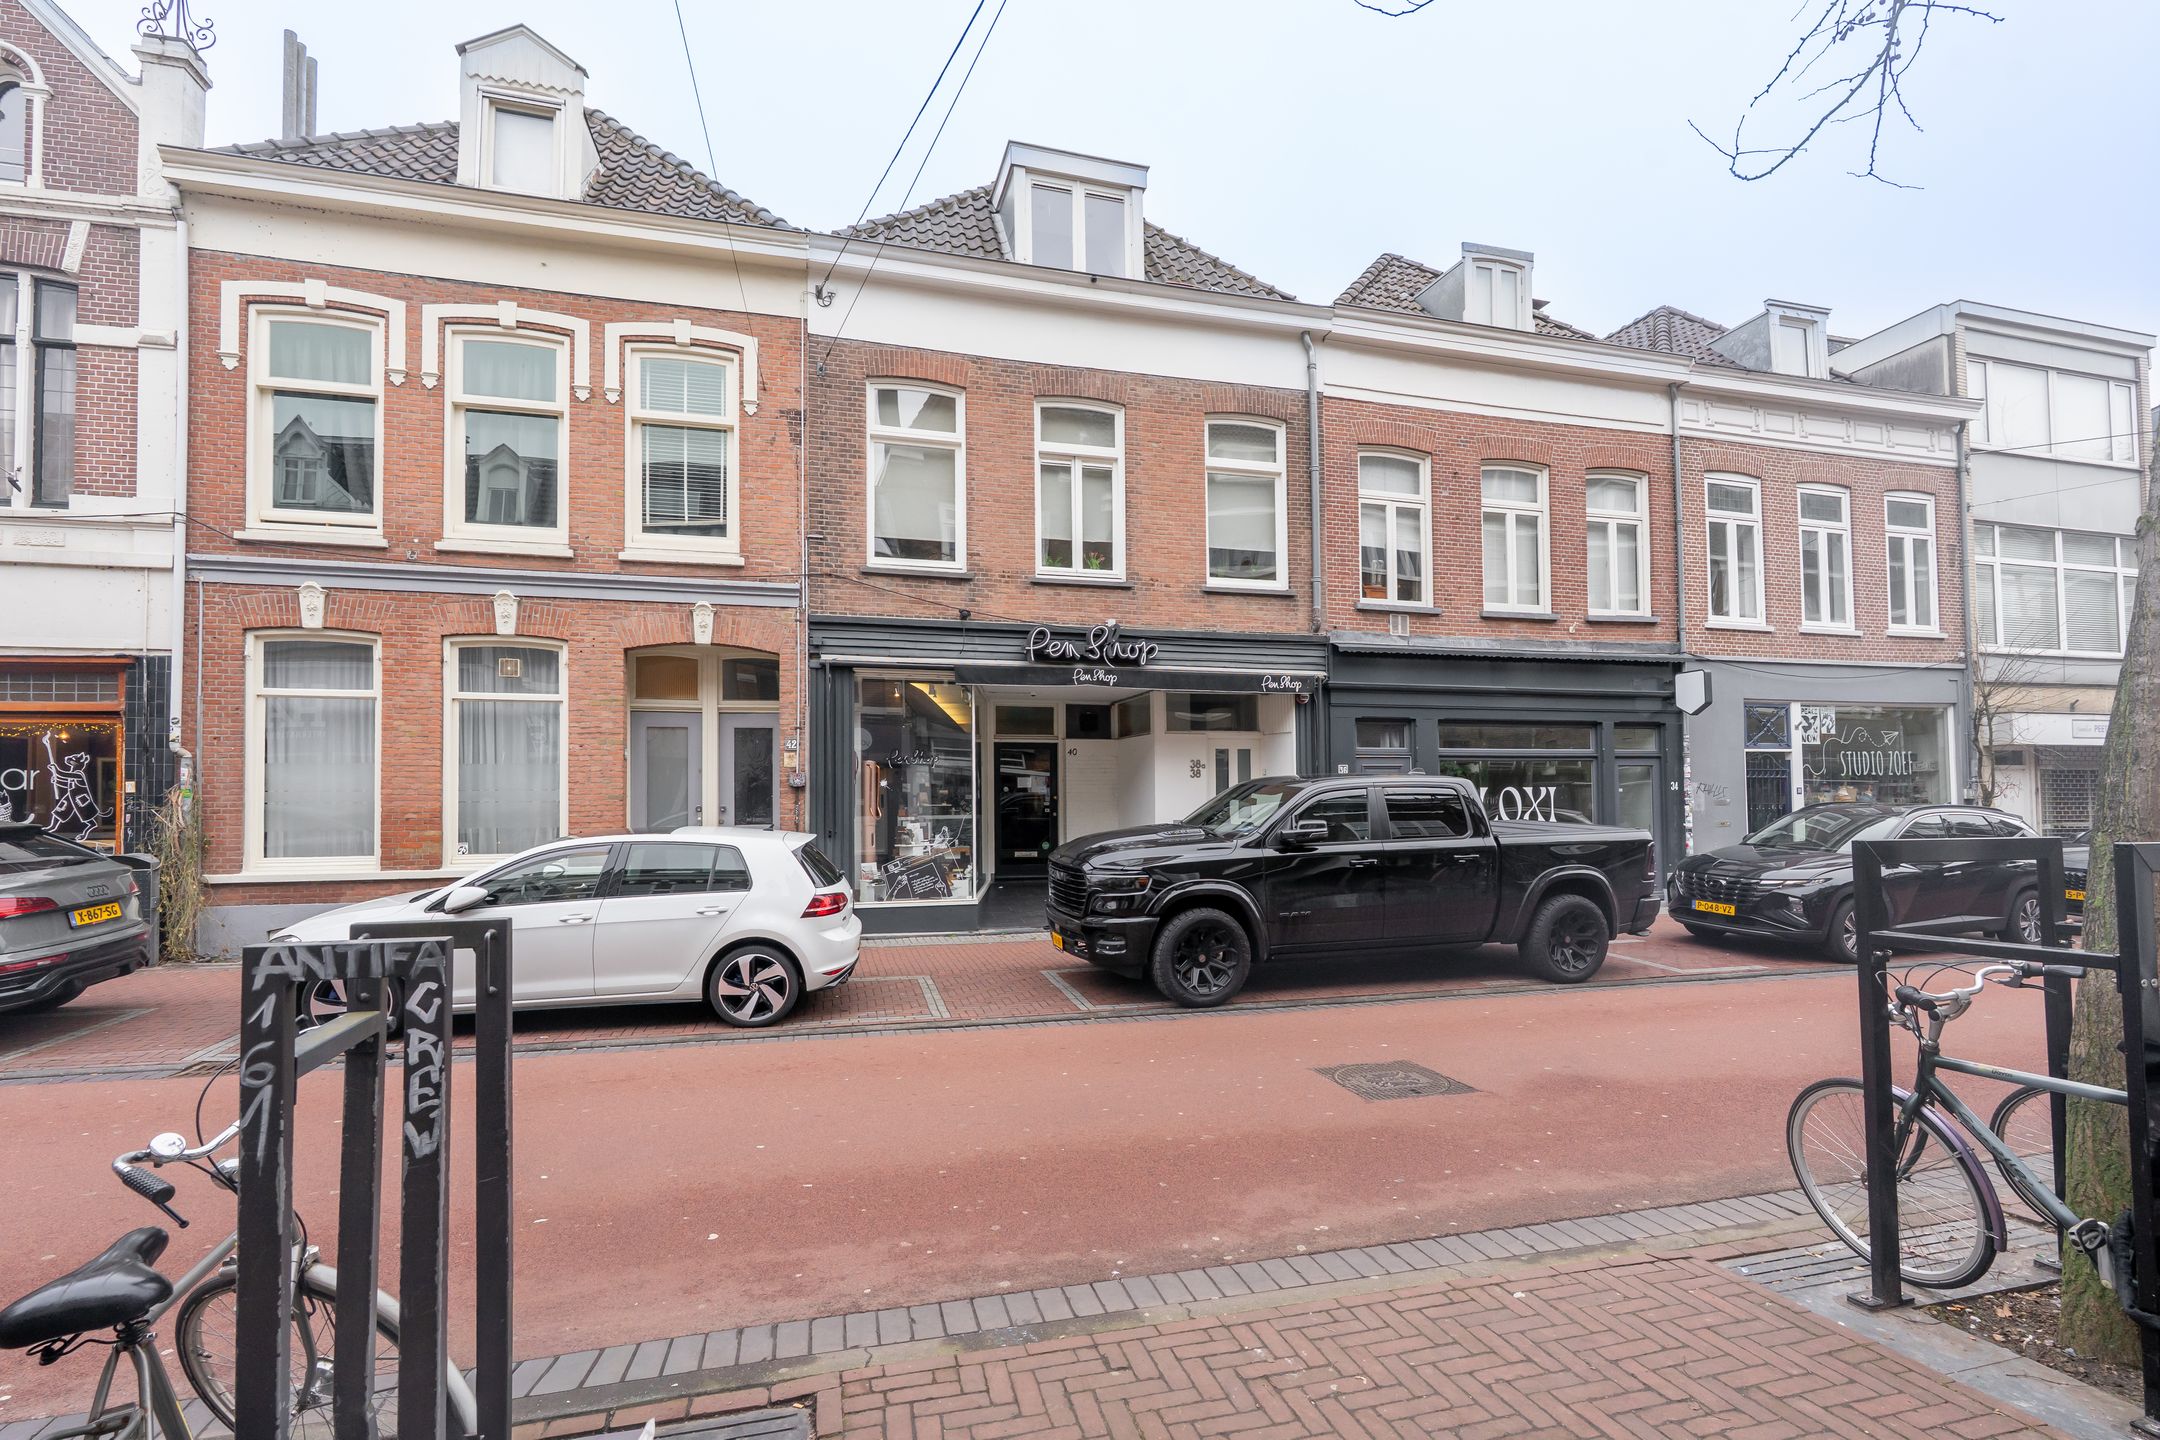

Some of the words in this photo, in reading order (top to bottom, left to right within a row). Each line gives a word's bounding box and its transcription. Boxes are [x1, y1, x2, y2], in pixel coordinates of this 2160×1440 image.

[1023, 626, 1081, 661] Pen
[1087, 624, 1160, 668] Shop
[1072, 668, 1093, 686] Pen
[1092, 668, 1118, 686] Shop
[1261, 675, 1280, 692] Pen
[1279, 675, 1303, 692] Shop
[785, 739, 797, 749] 42
[1067, 747, 1078, 756] 40
[1840, 750, 1884, 776] STUDIO
[1887, 750, 1913, 776] ZOEF
[1189, 769, 1201, 779] 38
[1670, 781, 1679, 791] 34
[76, 904, 118, 923] X-867-SG
[1697, 901, 1733, 914] P-048-VZ
[252, 941, 447, 991] ANTIFA
